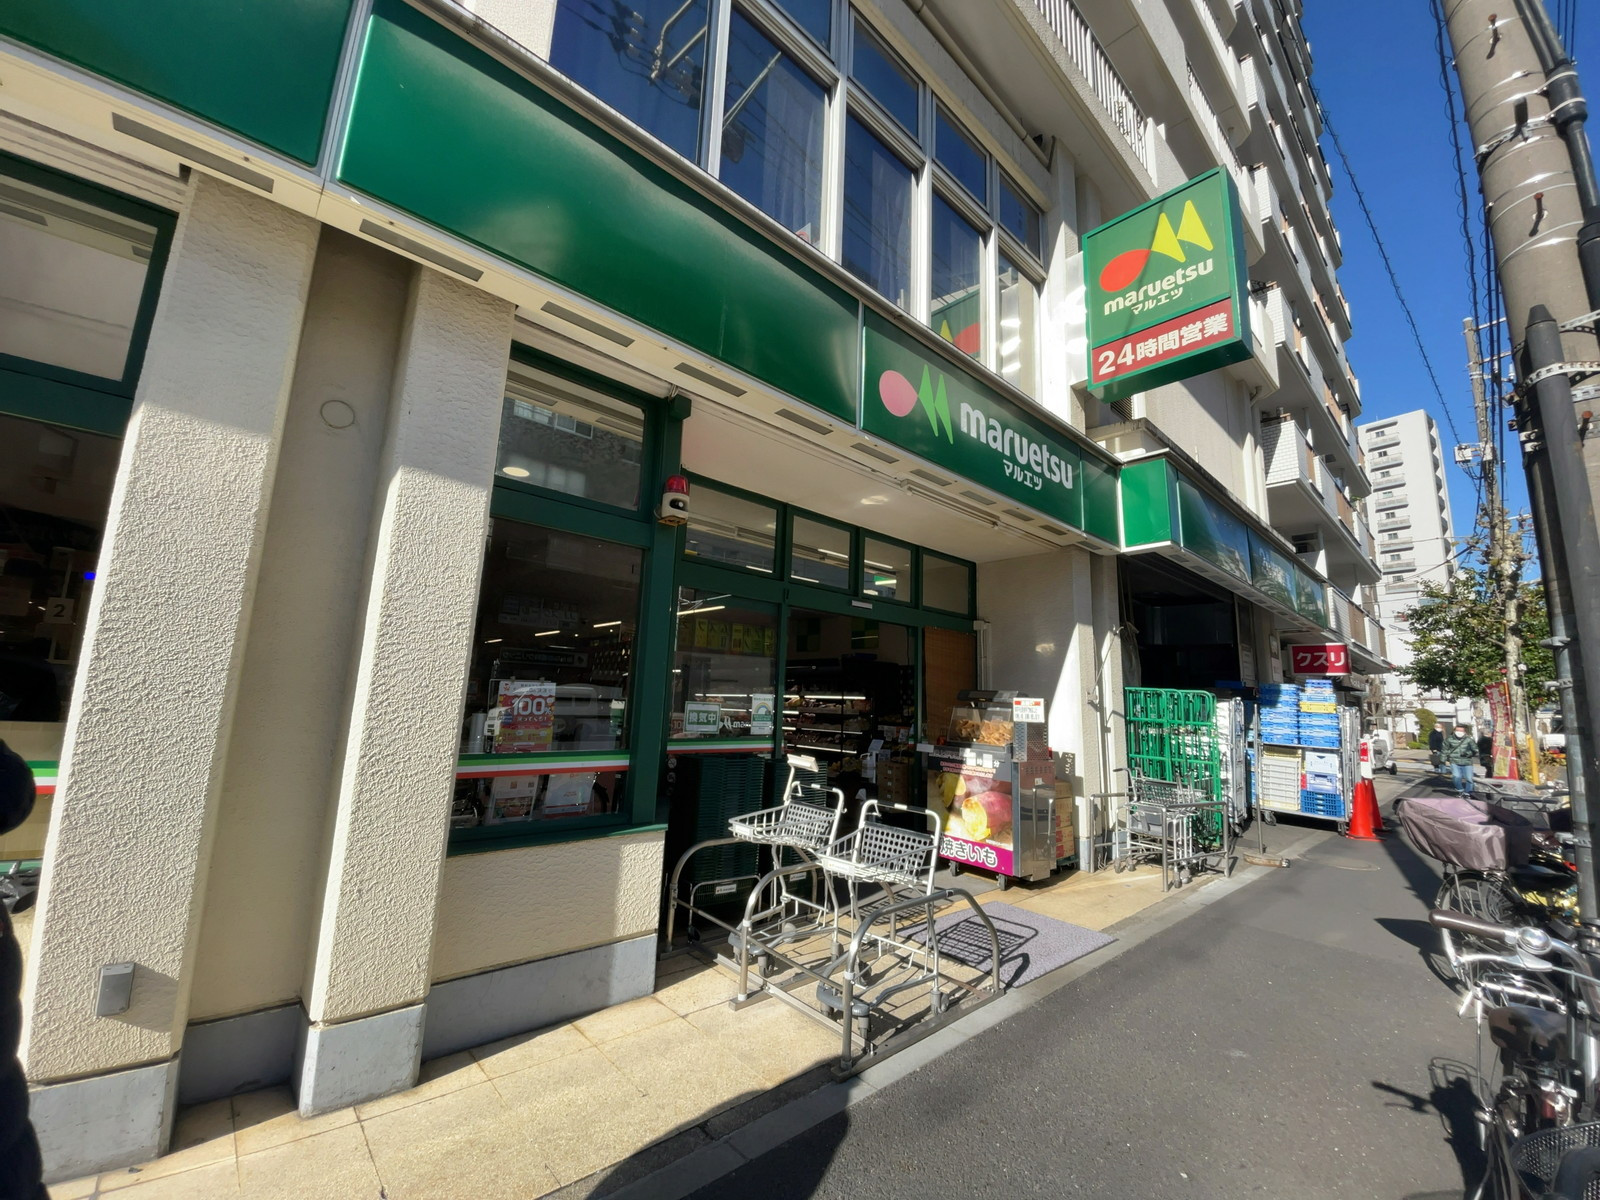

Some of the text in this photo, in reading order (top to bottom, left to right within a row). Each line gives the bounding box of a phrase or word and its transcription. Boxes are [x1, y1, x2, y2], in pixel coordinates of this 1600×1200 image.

[1104, 258, 1213, 316] maruetsu
[1131, 286, 1183, 315] マルエツ
[1098, 312, 1228, 376] 24時間営業
[960, 402, 1073, 490] maruetsu
[1003, 459, 1042, 491] マルエツ
[53, 603, 66, 617] 2
[1296, 651, 1346, 667] クスリ
[940, 837, 998, 868] 焼きいも
